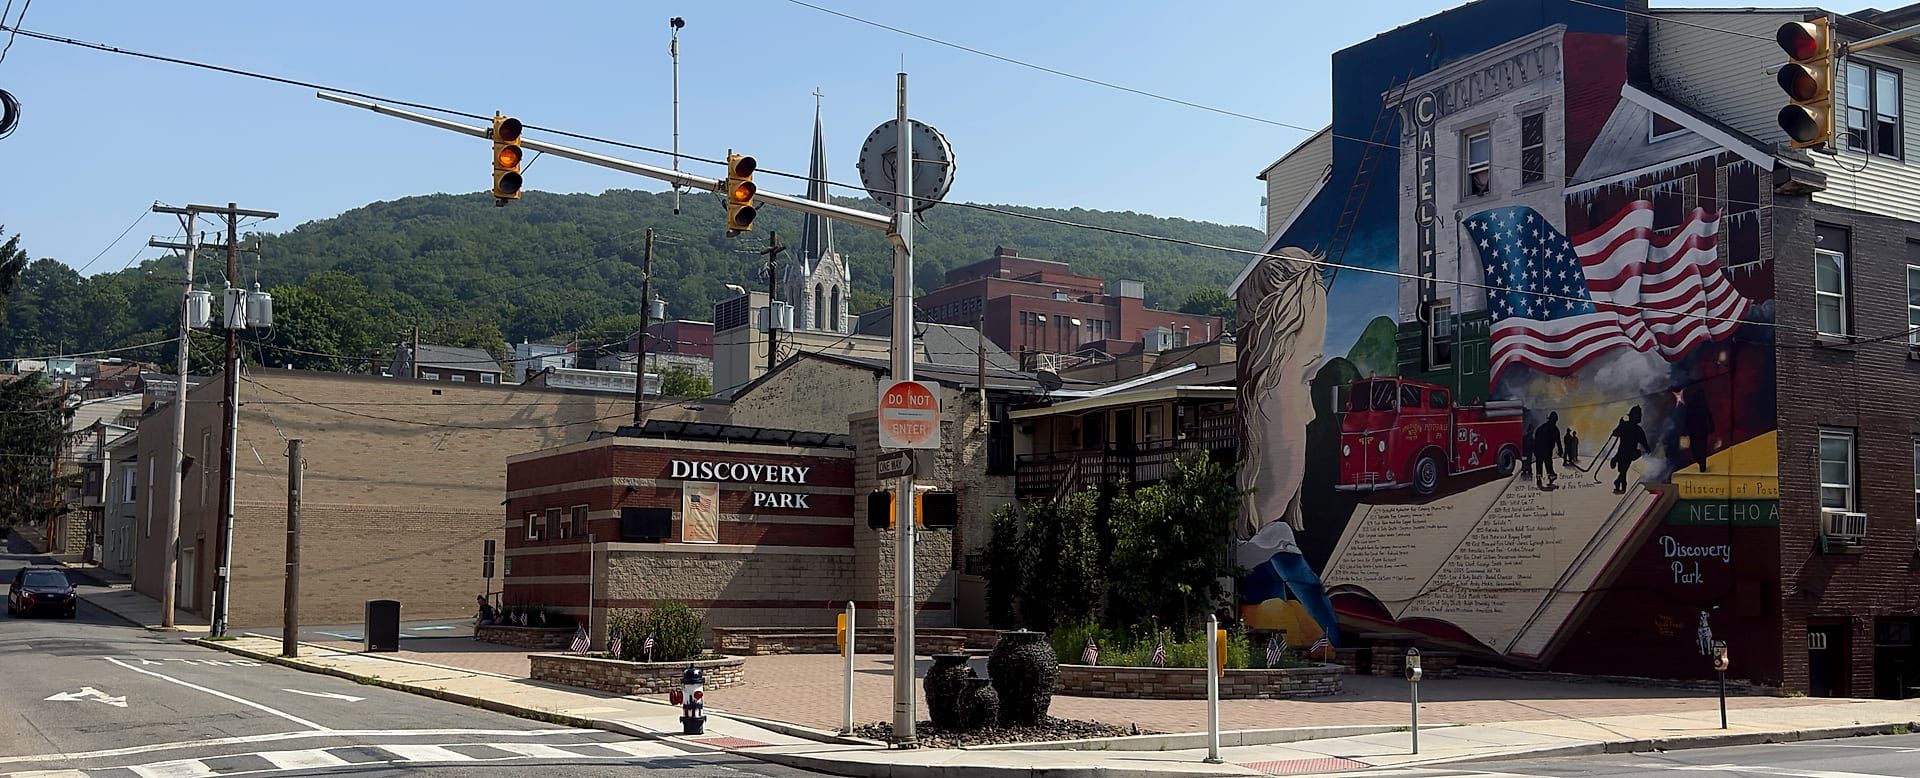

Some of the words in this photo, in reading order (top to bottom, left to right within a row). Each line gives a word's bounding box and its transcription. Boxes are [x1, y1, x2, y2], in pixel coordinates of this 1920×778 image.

[888, 393, 903, 405] DO
[909, 395, 930, 406] NOT
[892, 423, 927, 435] ENTER
[671, 460, 810, 484] DISCOVERY
[880, 461, 890, 473] ONE
[891, 458, 903, 471] WAY
[1685, 481, 1724, 496] History
[1737, 484, 1747, 494] of
[754, 491, 810, 509] PARK
[1690, 504, 1760, 521] NECHO
[1659, 535, 1731, 562] Discovery
[1671, 561, 1703, 584] Park
